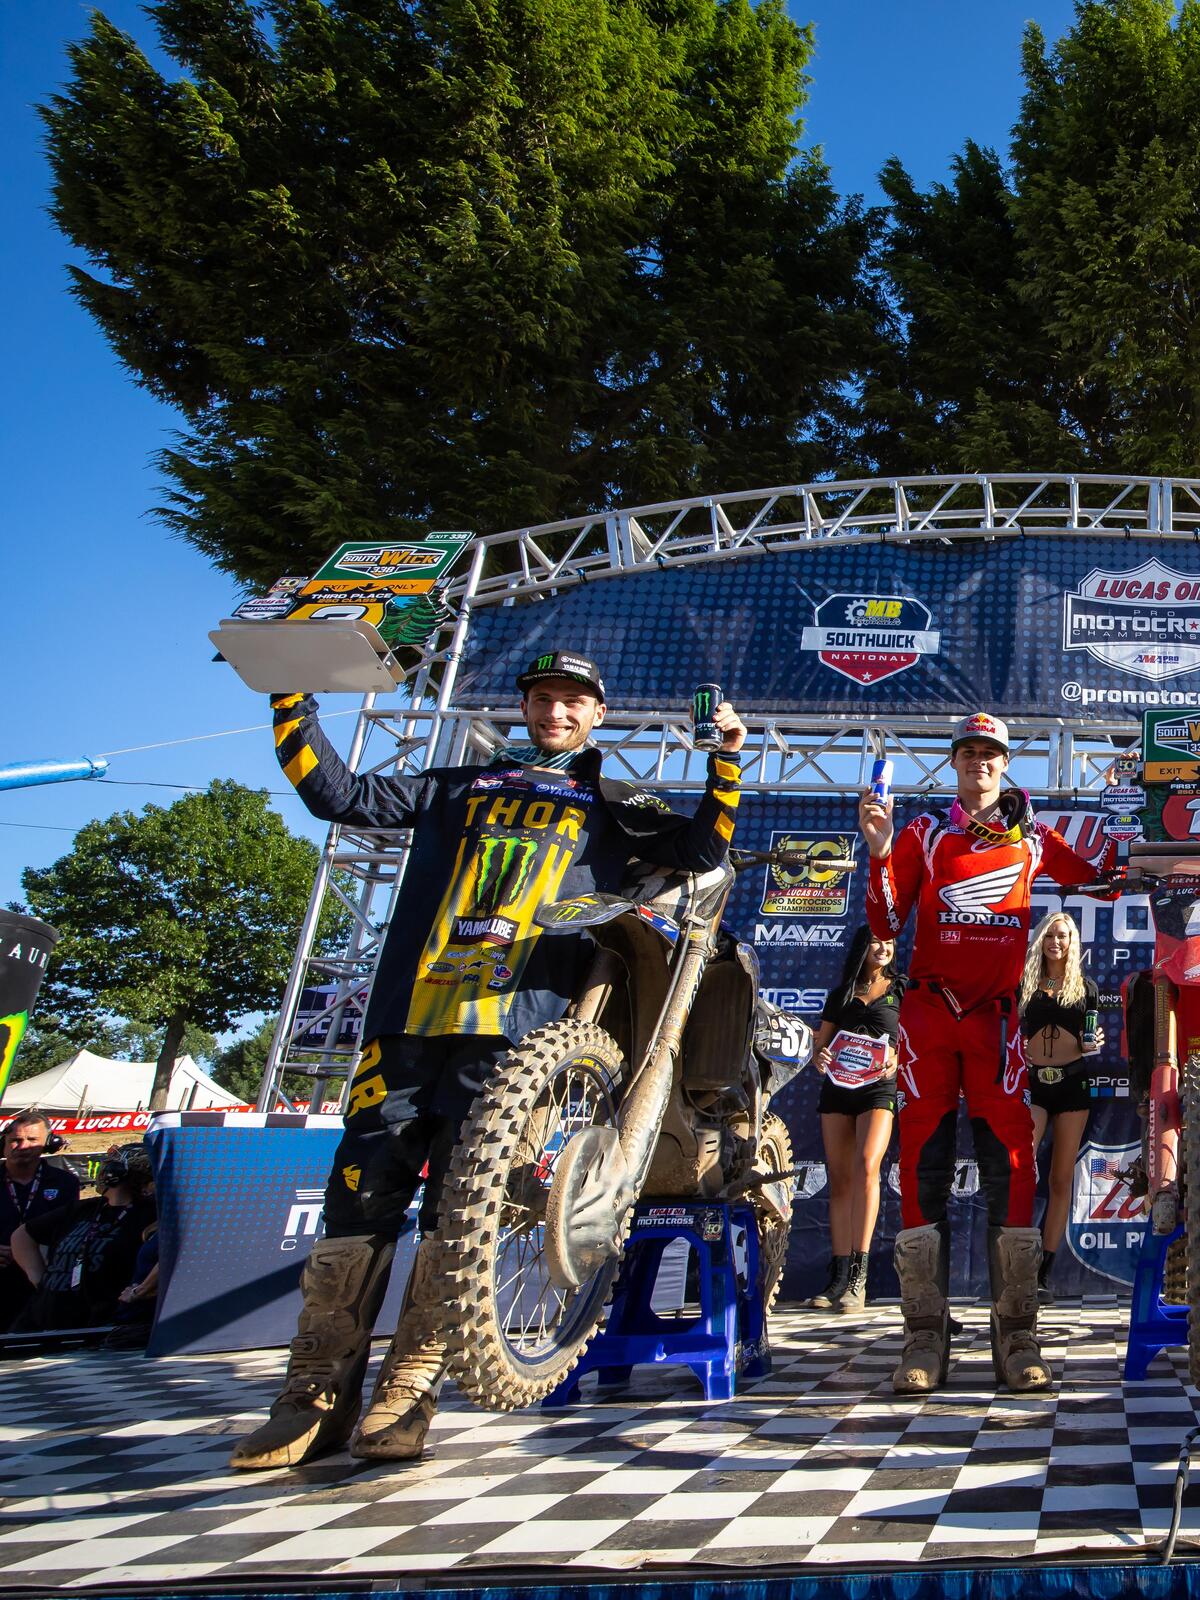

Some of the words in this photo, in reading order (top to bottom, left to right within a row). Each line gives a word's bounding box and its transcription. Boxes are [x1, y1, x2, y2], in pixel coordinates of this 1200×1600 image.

[370, 566, 395, 574] 338
[279, 578, 299, 588] 50
[311, 592, 348, 600] THIRD
[351, 592, 394, 600] PLACE
[1095, 579, 1171, 602] LUCAS
[865, 599, 904, 618] MB
[1134, 609, 1176, 617] PRO
[826, 631, 916, 649] SOUTHWICK
[569, 657, 592, 669] YAMAHA
[831, 653, 908, 662] NATIONAL
[1132, 654, 1163, 664] AMA
[1117, 759, 1135, 771] 50
[1160, 767, 1183, 775] EXIT
[549, 786, 593, 803] YAMAHA
[465, 795, 587, 842] THOR
[966, 820, 1014, 844] 100%
[780, 840, 843, 885] 50
[786, 888, 807, 898] LUCAS
[812, 888, 825, 897] OIL
[786, 897, 842, 906] MOTOCROSS
[775, 904, 832, 913] CHAMPIONSHIP
[938, 911, 1022, 929] HONDA
[754, 923, 847, 943] MAVTV
[754, 940, 808, 948] MOTORSPORTS
[777, 1015, 811, 1058] 32
[849, 1036, 867, 1046] LUCAS
[52, 1117, 67, 1130] IL
[75, 1115, 135, 1131] LUCAS
[650, 1208, 674, 1216] LUCAS
[674, 1207, 686, 1215] OIL
[705, 1223, 721, 1234] 50
[1079, 1232, 1118, 1249] OIL
